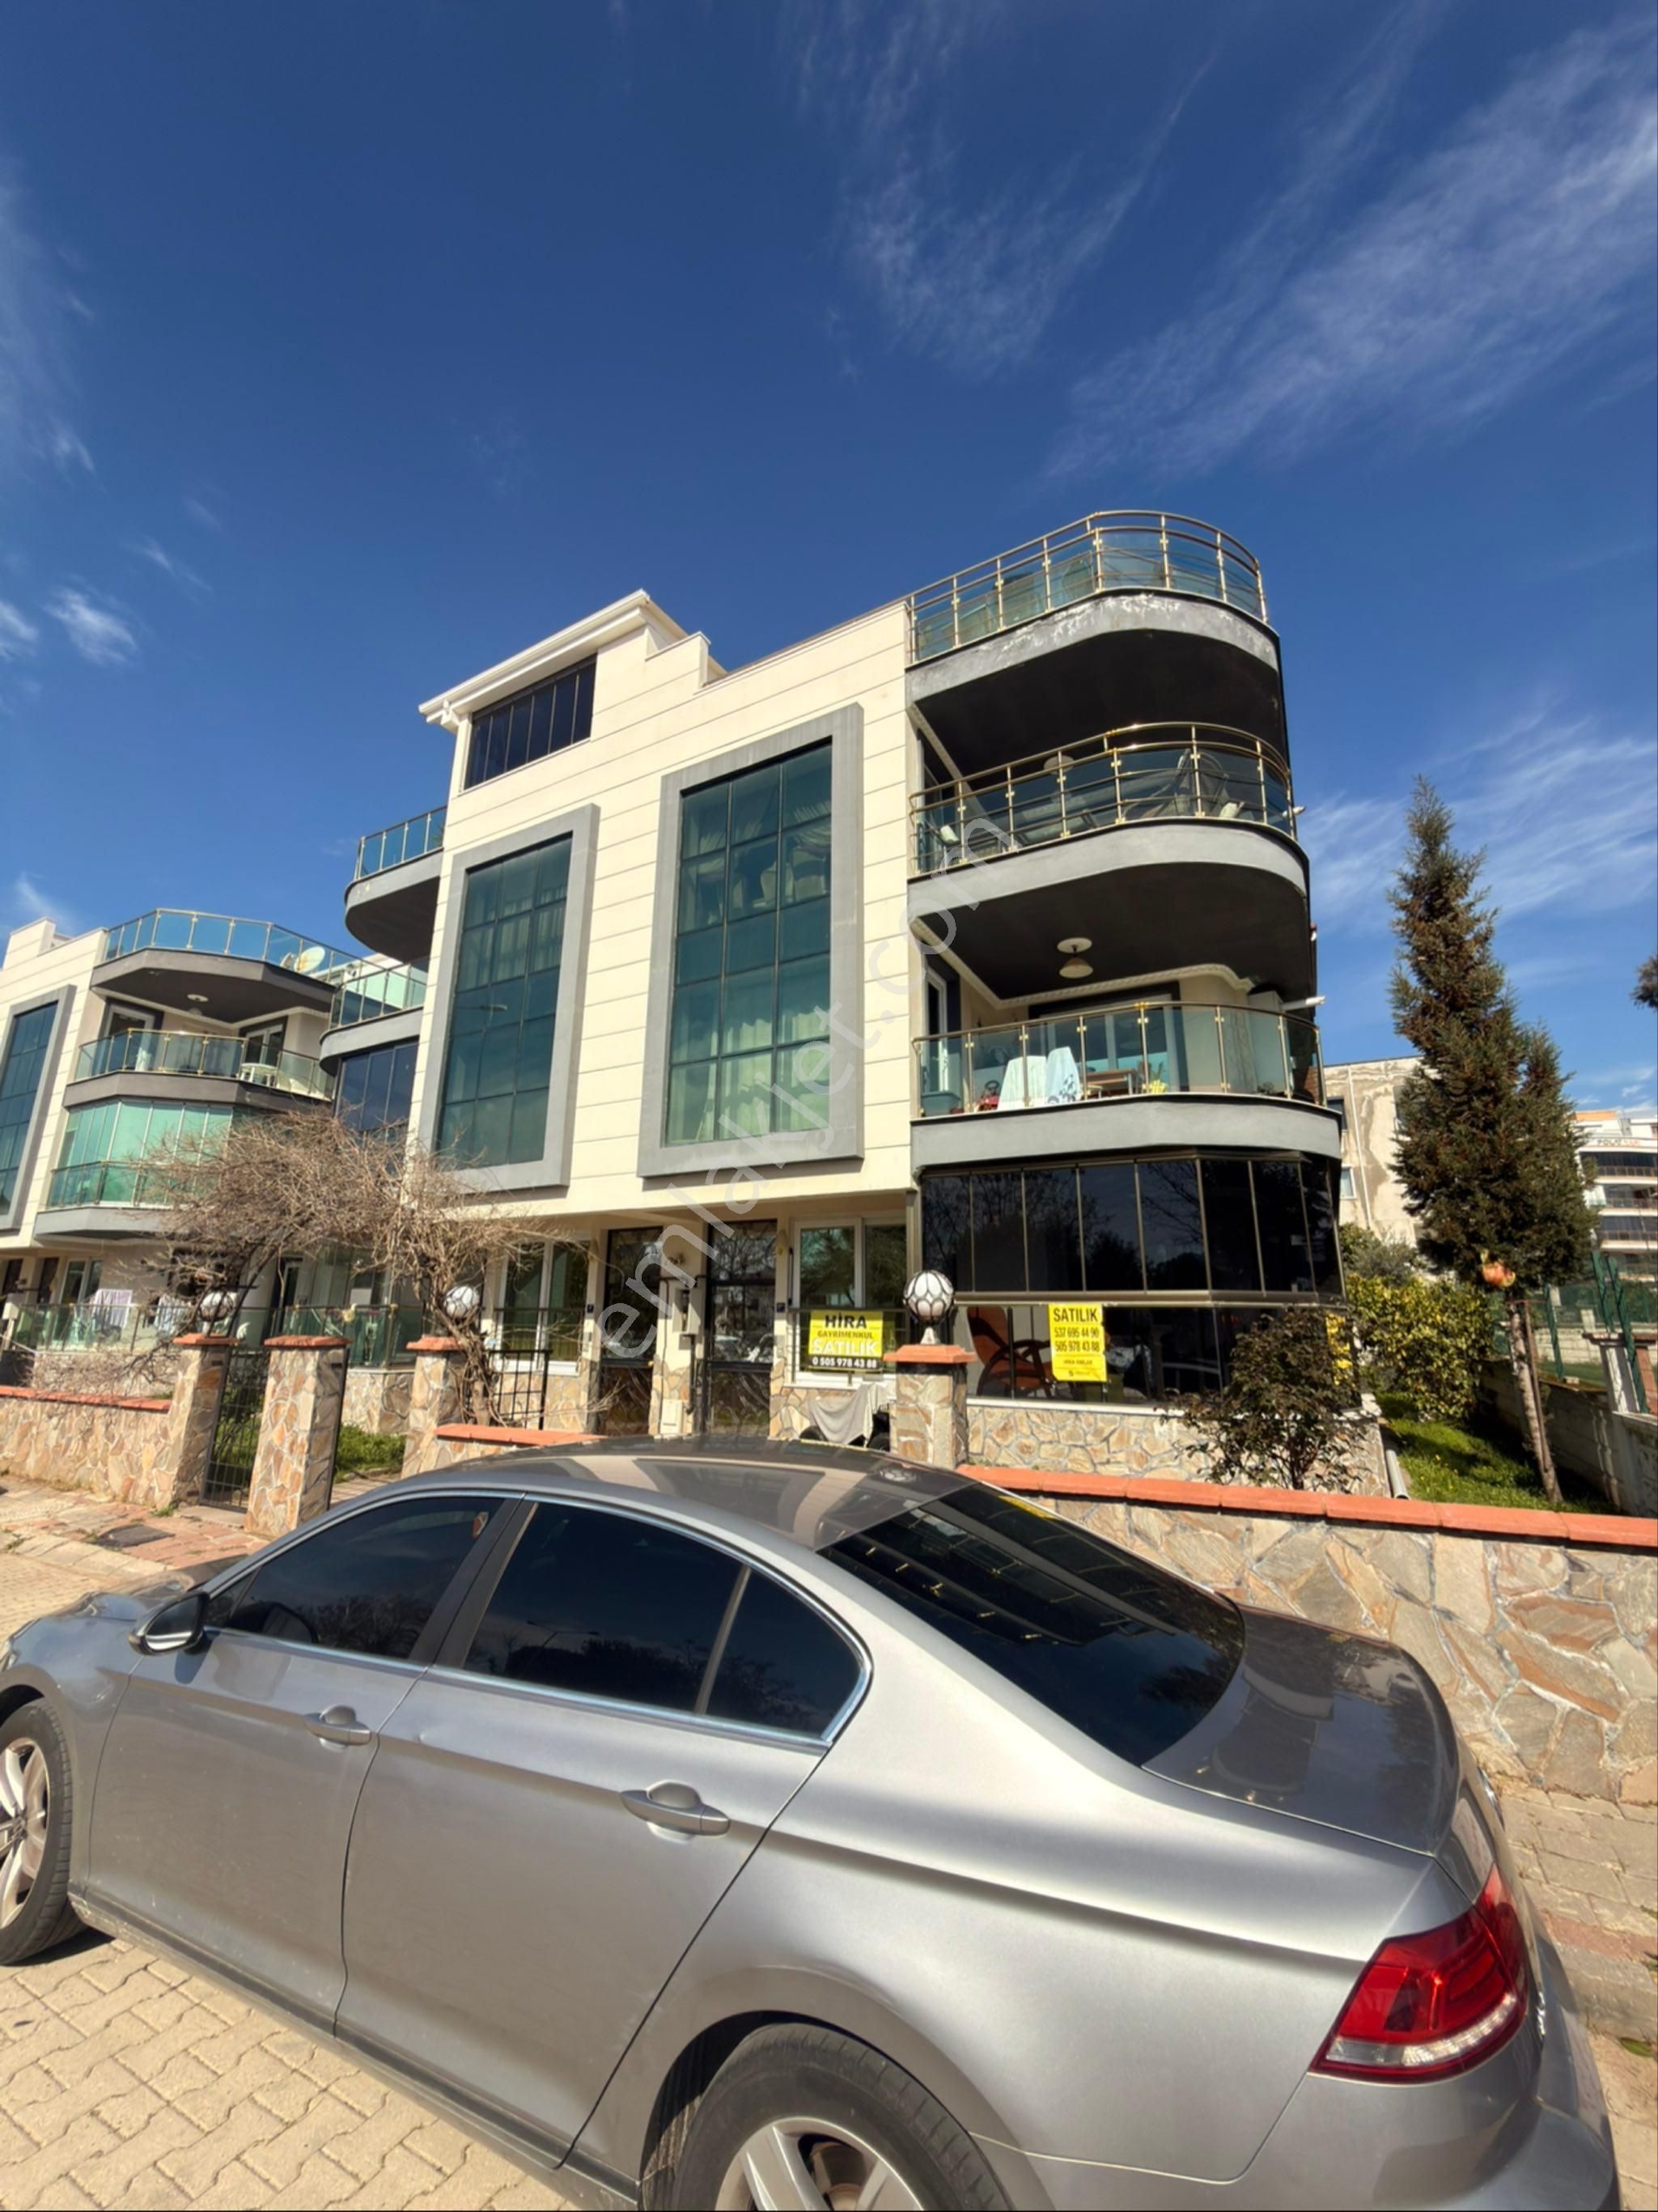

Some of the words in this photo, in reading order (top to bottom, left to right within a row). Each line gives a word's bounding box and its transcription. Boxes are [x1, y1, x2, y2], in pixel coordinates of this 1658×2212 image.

[1054, 1308, 1098, 1322] SATILIK
[812, 1339, 877, 1356] SATILIK
[812, 1356, 818, 1365] 0
[820, 1357, 835, 1366] 505
[837, 1358, 852, 1367] 978
[854, 1358, 865, 1368] 43
[867, 1360, 877, 1369] 88
